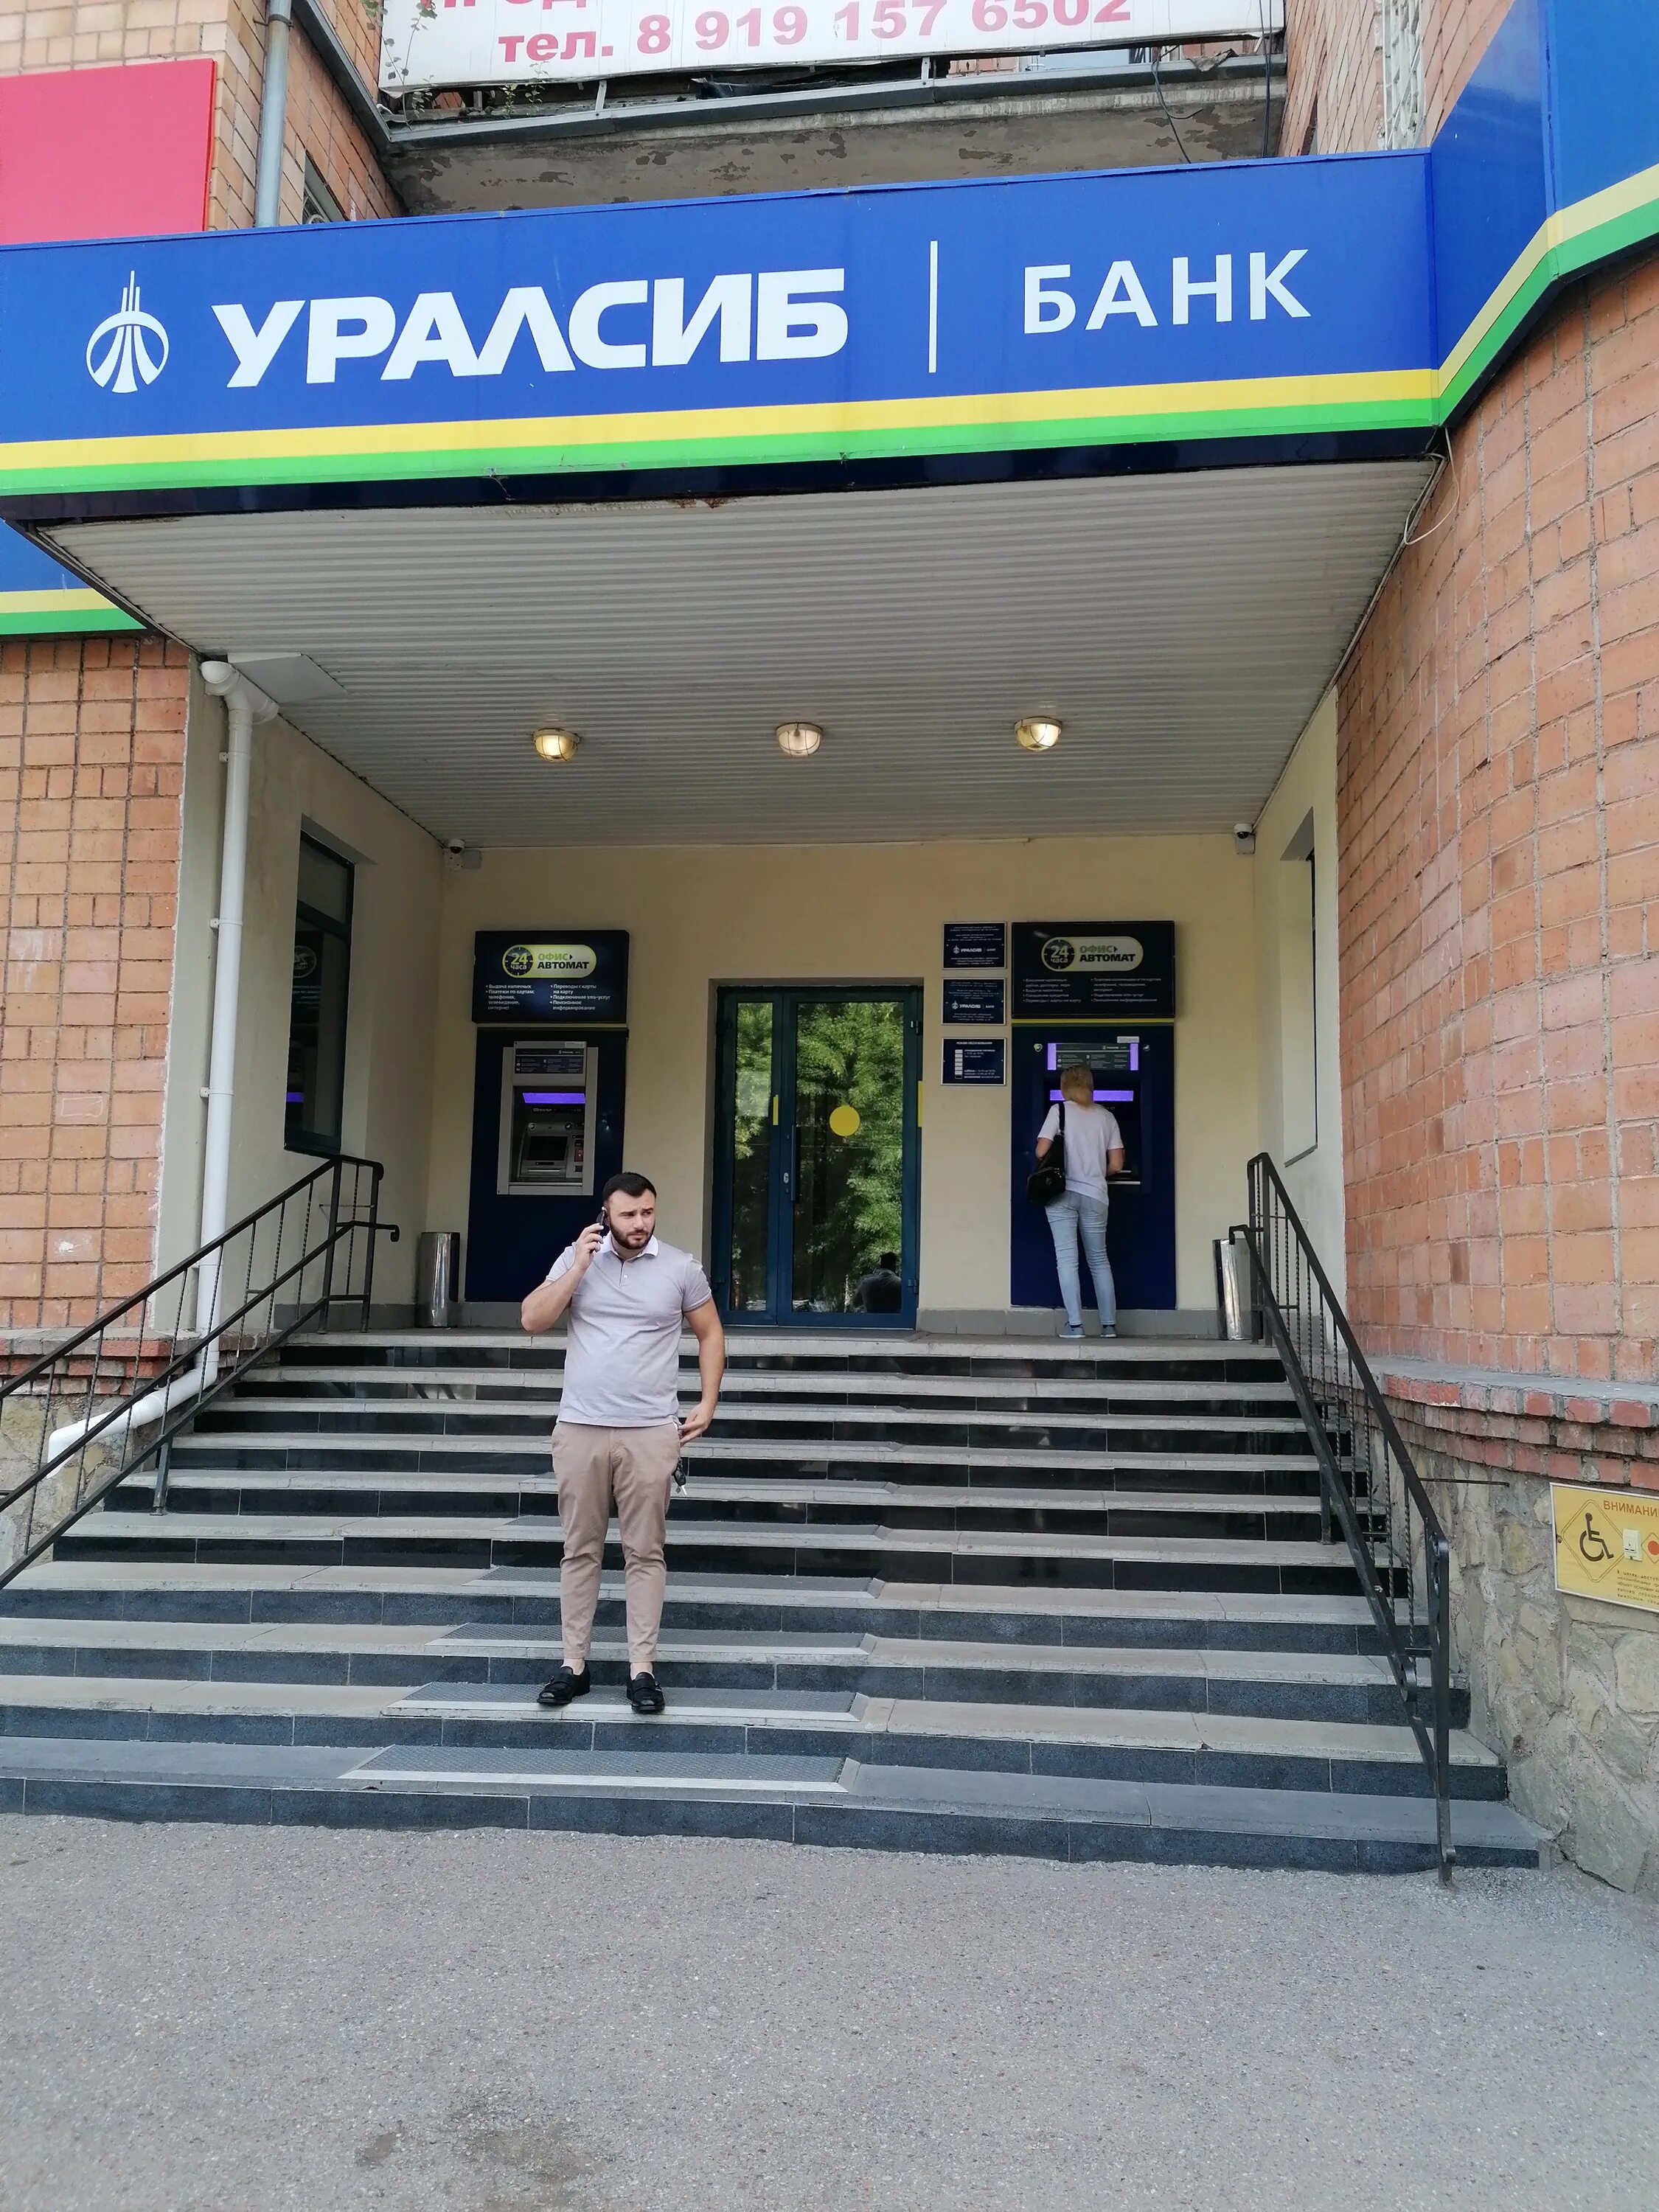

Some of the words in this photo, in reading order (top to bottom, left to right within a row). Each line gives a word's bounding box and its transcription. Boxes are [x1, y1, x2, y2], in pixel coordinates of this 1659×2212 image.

[498, 31, 613, 63] тел.
[637, 14, 671, 54] 8
[695, 5, 807, 50] 919
[834, 0, 947, 41] 157
[972, 0, 1131, 32] 6502
[211, 268, 849, 389] УРАЛСИБ
[1024, 248, 1312, 334] БАНК
[1051, 945, 1069, 958] 24
[1079, 945, 1113, 953] ОФИС
[511, 953, 529, 964] 24
[538, 953, 568, 961] ОФИС
[1079, 953, 1136, 962] АВТОМАТ
[537, 961, 590, 970] АВТОМАТ
[1604, 1500, 1659, 1517] ВНИМАНИ
